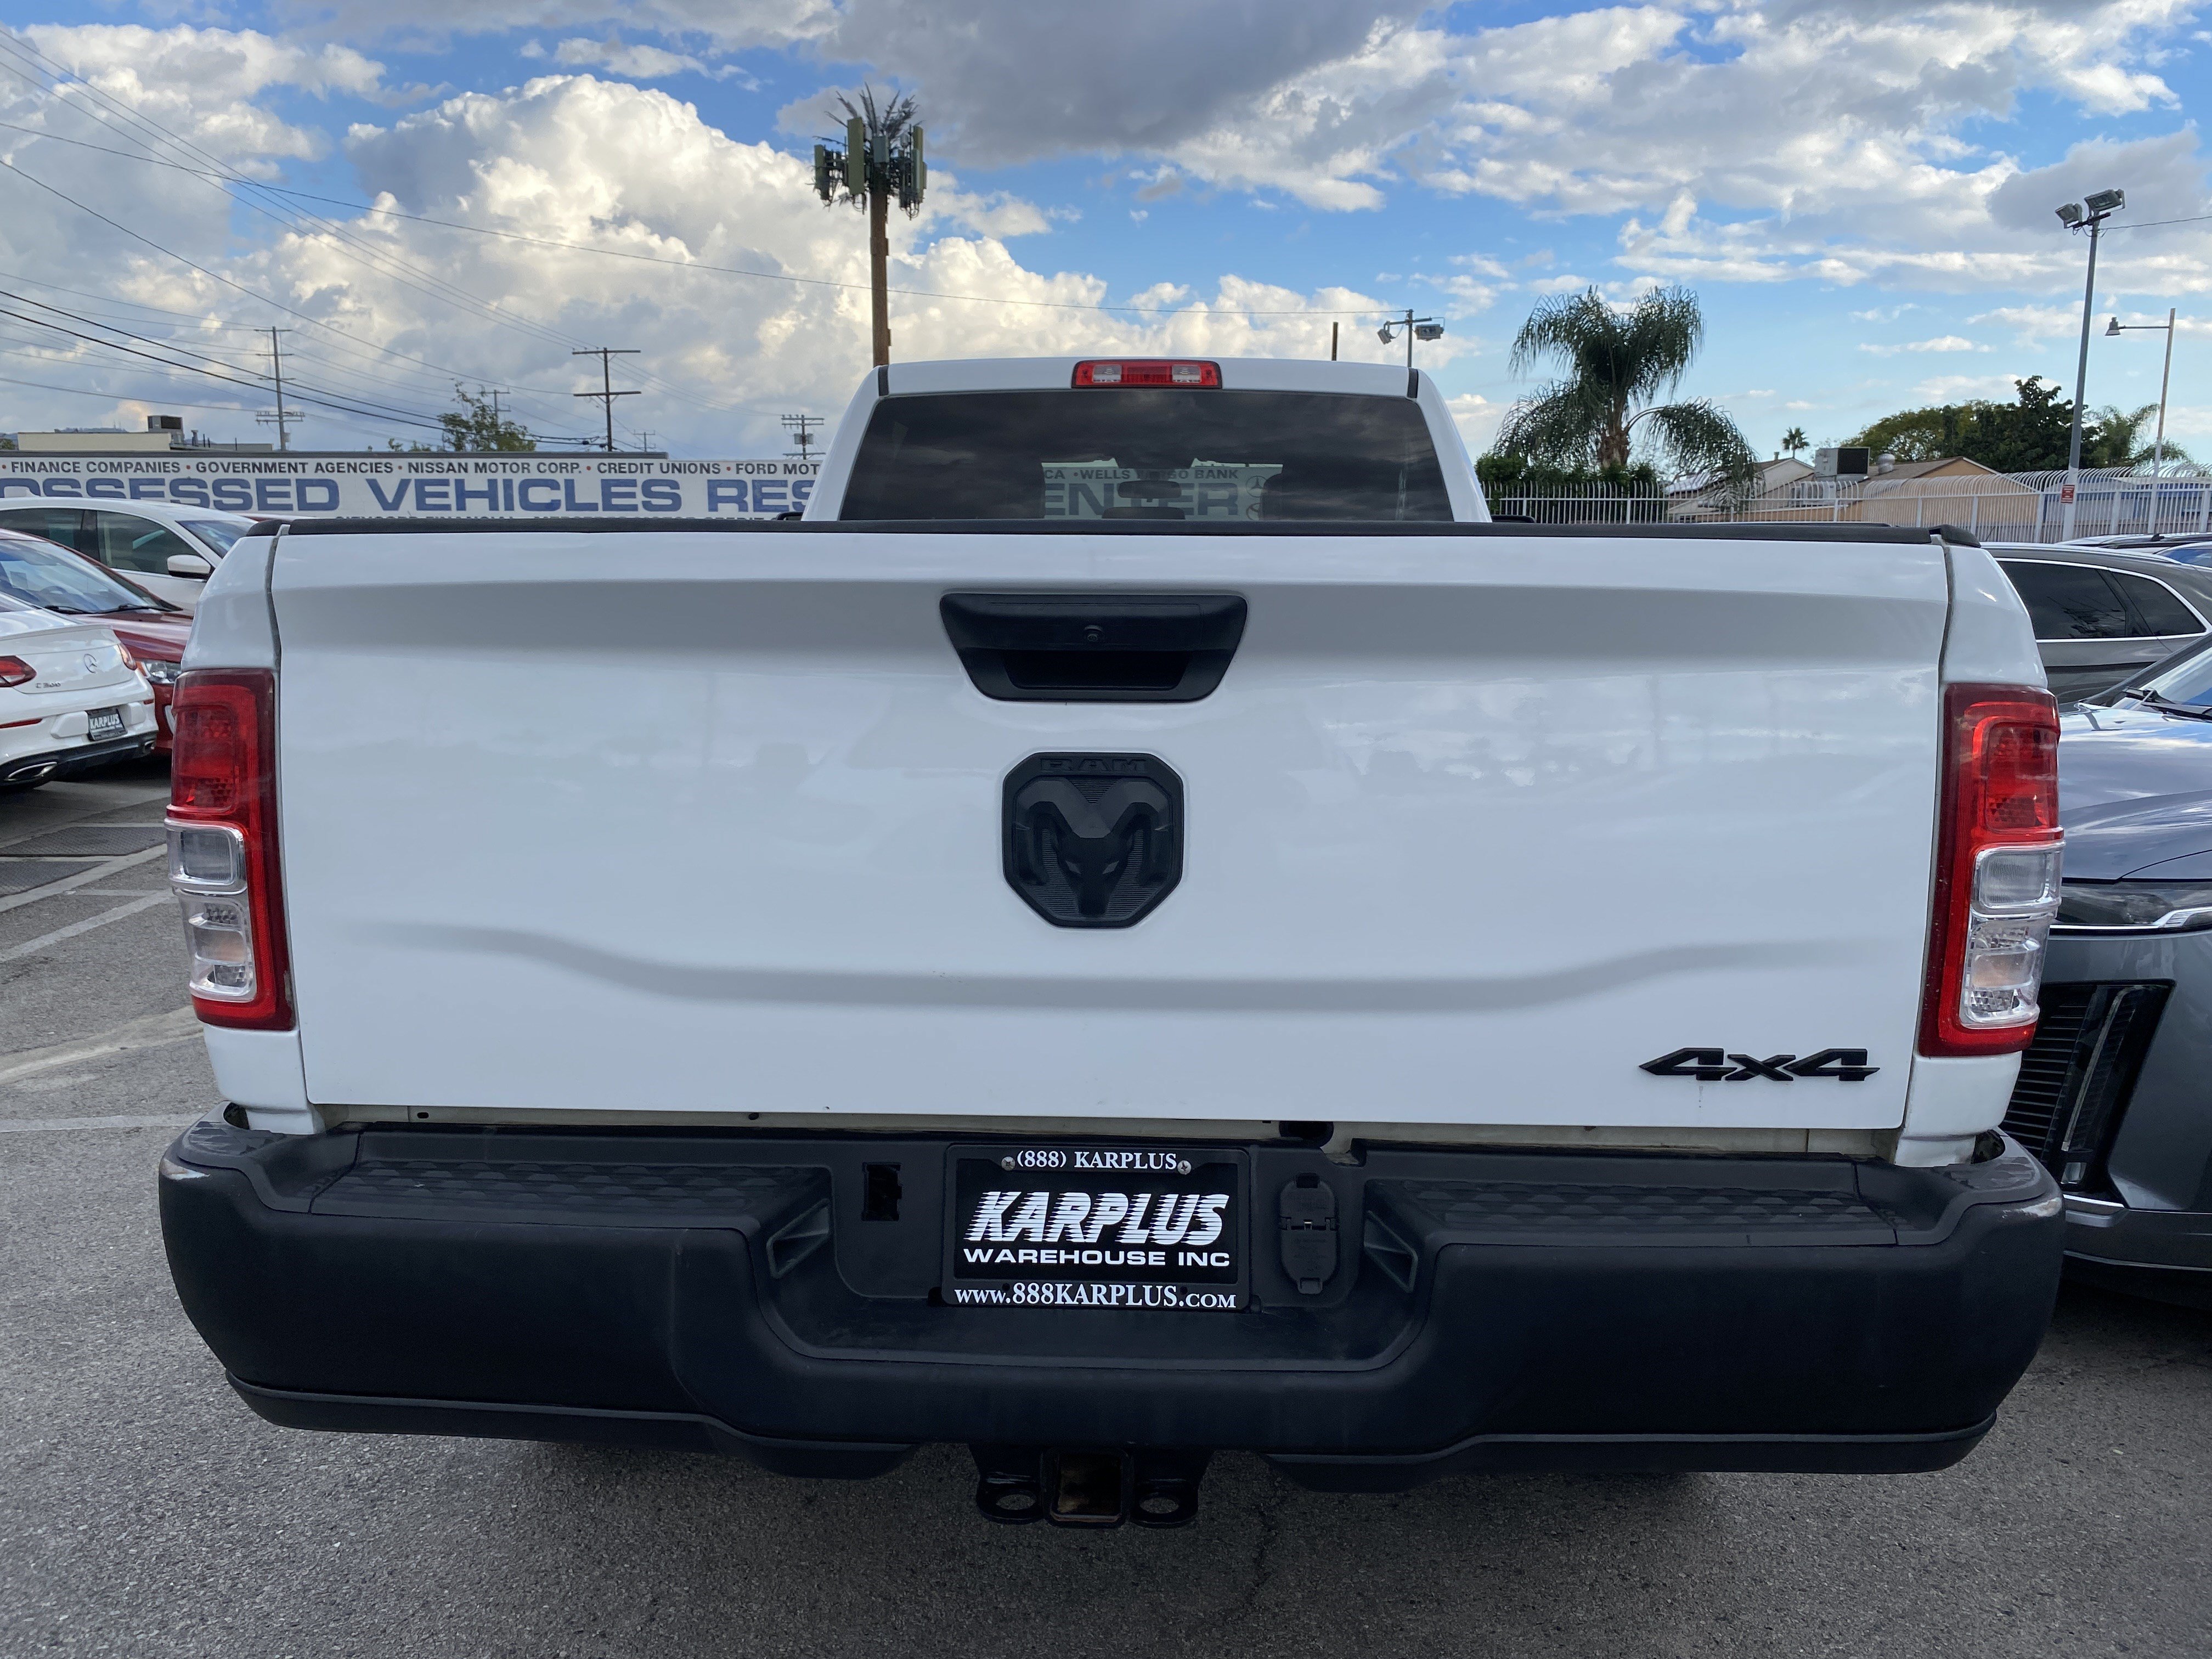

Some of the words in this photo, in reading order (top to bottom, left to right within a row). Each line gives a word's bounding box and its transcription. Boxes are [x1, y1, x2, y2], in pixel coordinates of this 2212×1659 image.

[11, 461, 81, 473] FINANCE
[86, 461, 180, 473] COMPANIES
[196, 462, 308, 473] GOVERNMENT
[314, 462, 393, 473] AGENCIES
[408, 462, 469, 473] NISSAN
[473, 462, 532, 473] MOTOR
[537, 462, 582, 474] CORP.
[597, 462, 653, 474] CREDIT
[659, 462, 721, 475] UNIONS
[736, 464, 777, 475] FORD
[1194, 470, 1239, 480] BANK
[366, 478, 682, 512] VEHICLES
[89, 713, 120, 730] KARPLUS
[1040, 758, 1147, 773] RAM
[1017, 1150, 1067, 1168] (888)
[1074, 1152, 1177, 1170] KARPLUS
[963, 1191, 1230, 1246] KARPLUS
[963, 1248, 1166, 1266] WAREHOUSE
[1178, 1251, 1230, 1267] INC
